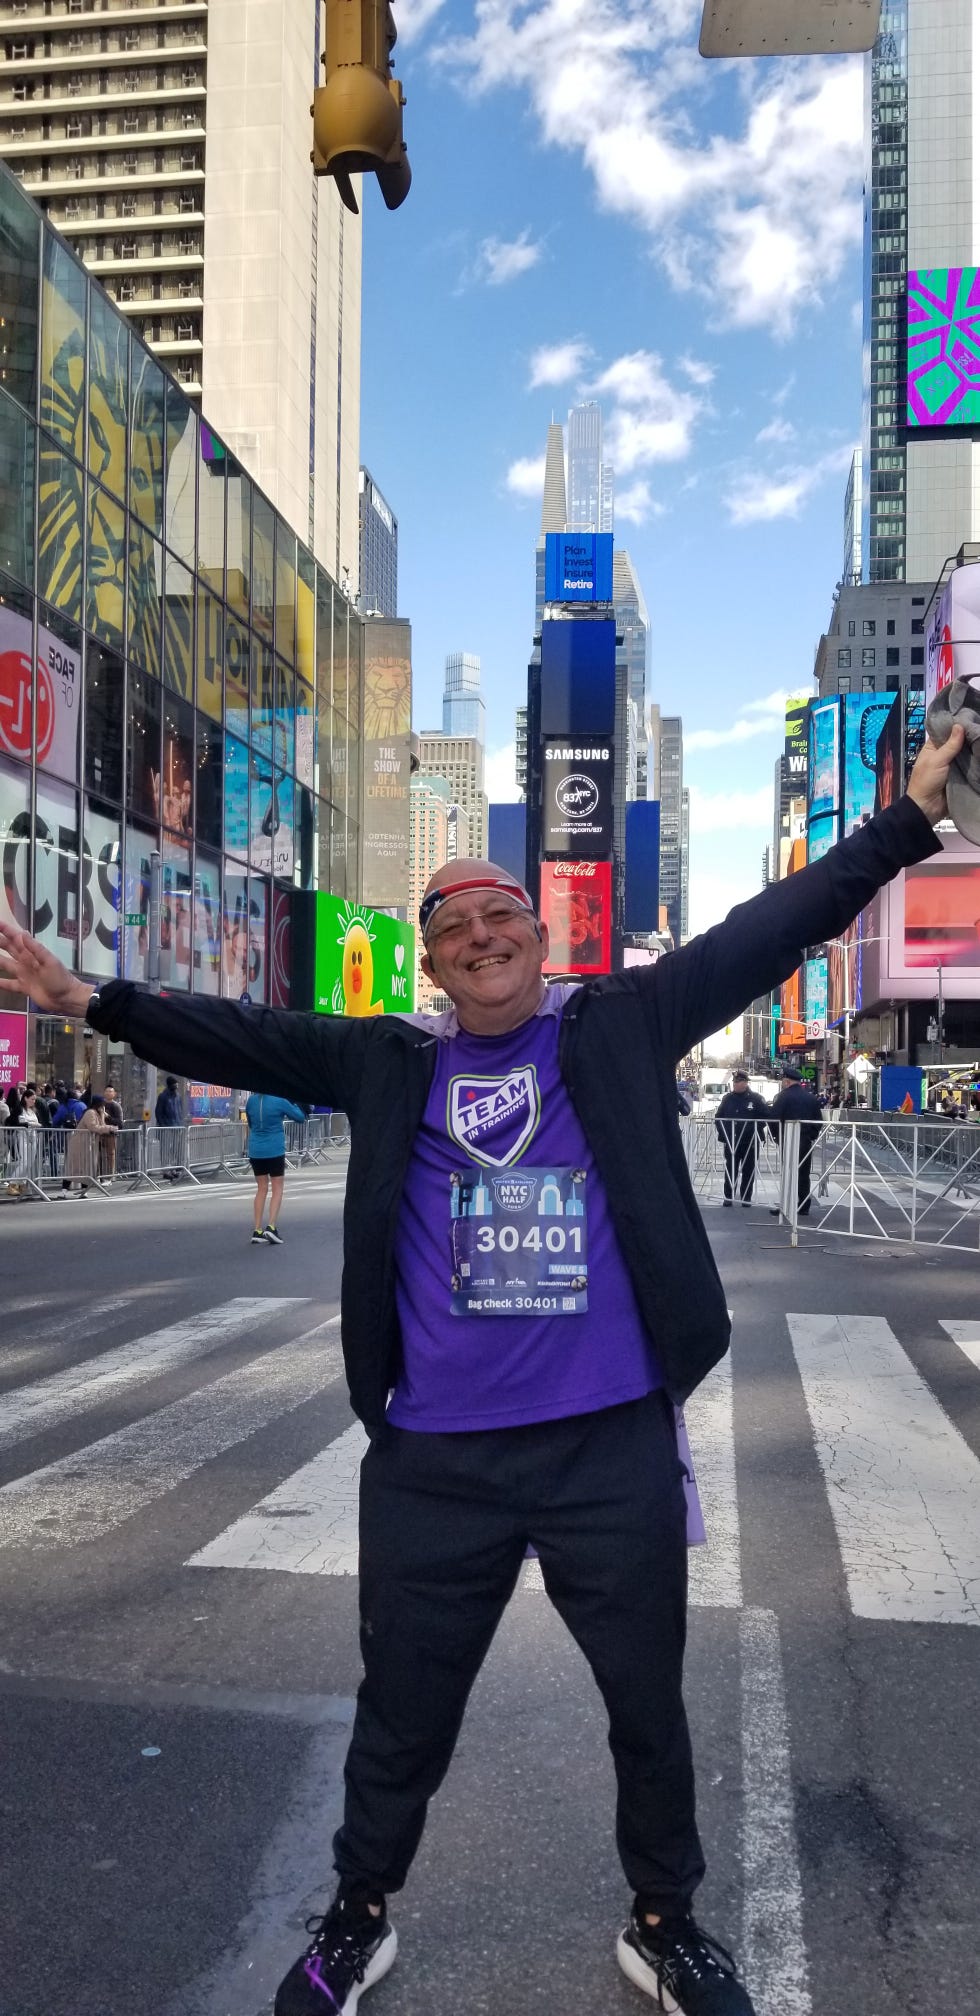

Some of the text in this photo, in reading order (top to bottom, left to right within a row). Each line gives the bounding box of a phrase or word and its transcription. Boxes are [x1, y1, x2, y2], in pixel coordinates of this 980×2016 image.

[564, 546, 586, 555] Plan
[564, 557, 593, 566] Invest
[564, 568, 593, 577] Insure
[563, 579, 593, 589] Retire
[378, 748, 396, 760] THE
[545, 748, 610, 760] SAMSUNG
[374, 760, 401, 773] SHOW
[377, 774, 397, 785] OF A
[367, 786, 408, 799] LIFETIME
[563, 792, 579, 802] 837
[365, 841, 408, 849] INGRESSOS
[554, 861, 598, 876] Coca-Cola
[3, 811, 121, 953] CBS
[131, 915, 140, 924] 44
[391, 974, 407, 998] NYC
[2, 1055, 20, 1068] SPACE
[458, 1077, 527, 1127] TEAM
[467, 1098, 526, 1140] IN TRAINING
[500, 1185, 528, 1196] NYC
[502, 1196, 526, 1204] HALF
[476, 1226, 581, 1253] 30401
[551, 1265, 577, 1274] WAVE
[468, 1297, 557, 1310] Bag Check 30401
